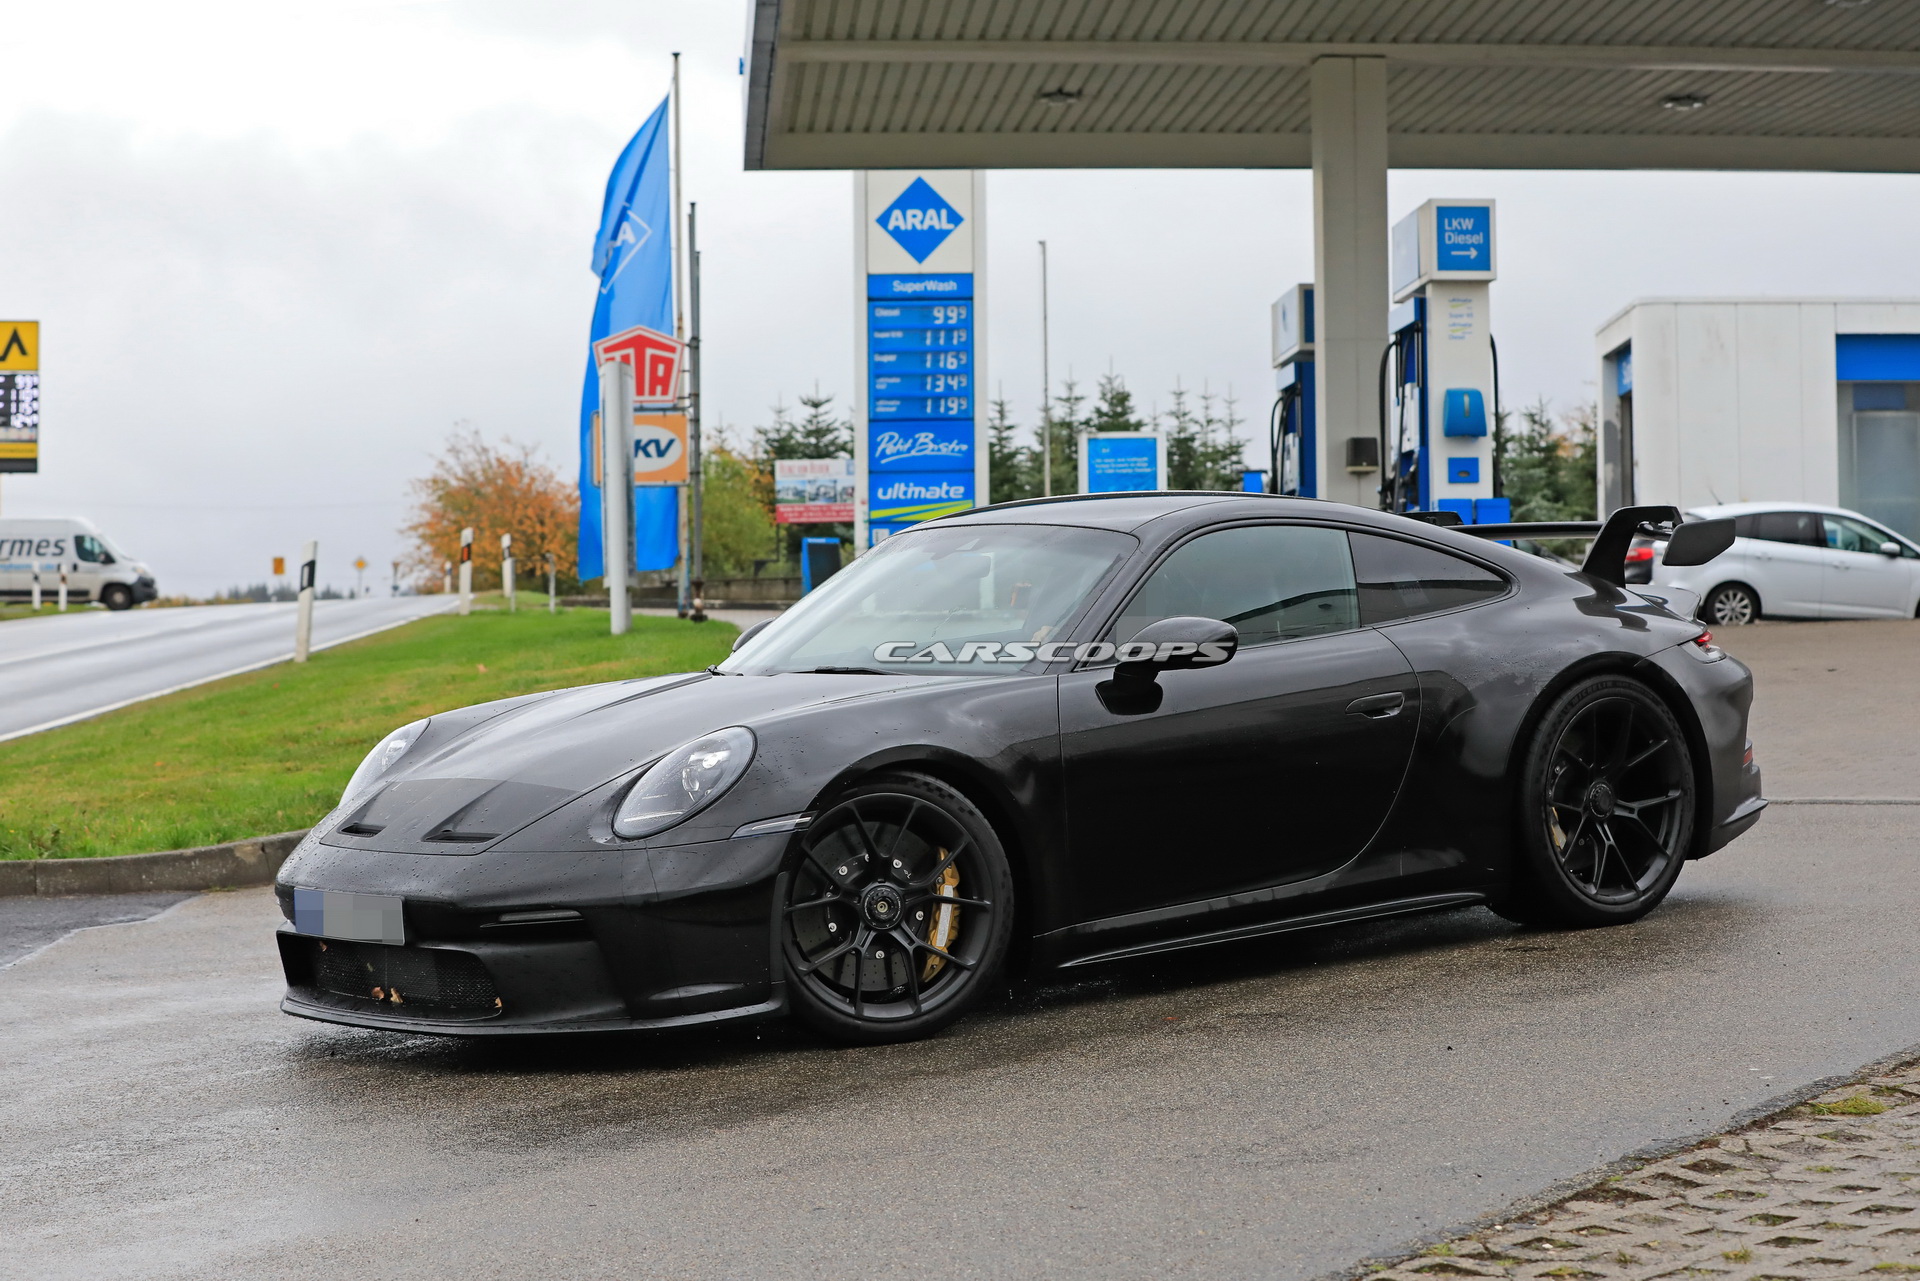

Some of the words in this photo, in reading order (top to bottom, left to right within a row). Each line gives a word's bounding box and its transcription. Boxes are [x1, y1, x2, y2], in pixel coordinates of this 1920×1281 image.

[887, 208, 955, 231] ARAL
[1444, 218, 1474, 230] LKW
[1445, 232, 1484, 244] Diesel
[892, 280, 958, 293] SuperWash
[603, 334, 677, 397] TA
[634, 438, 676, 458] KV
[877, 482, 965, 499] ultimate
[0, 538, 66, 557] rmes
